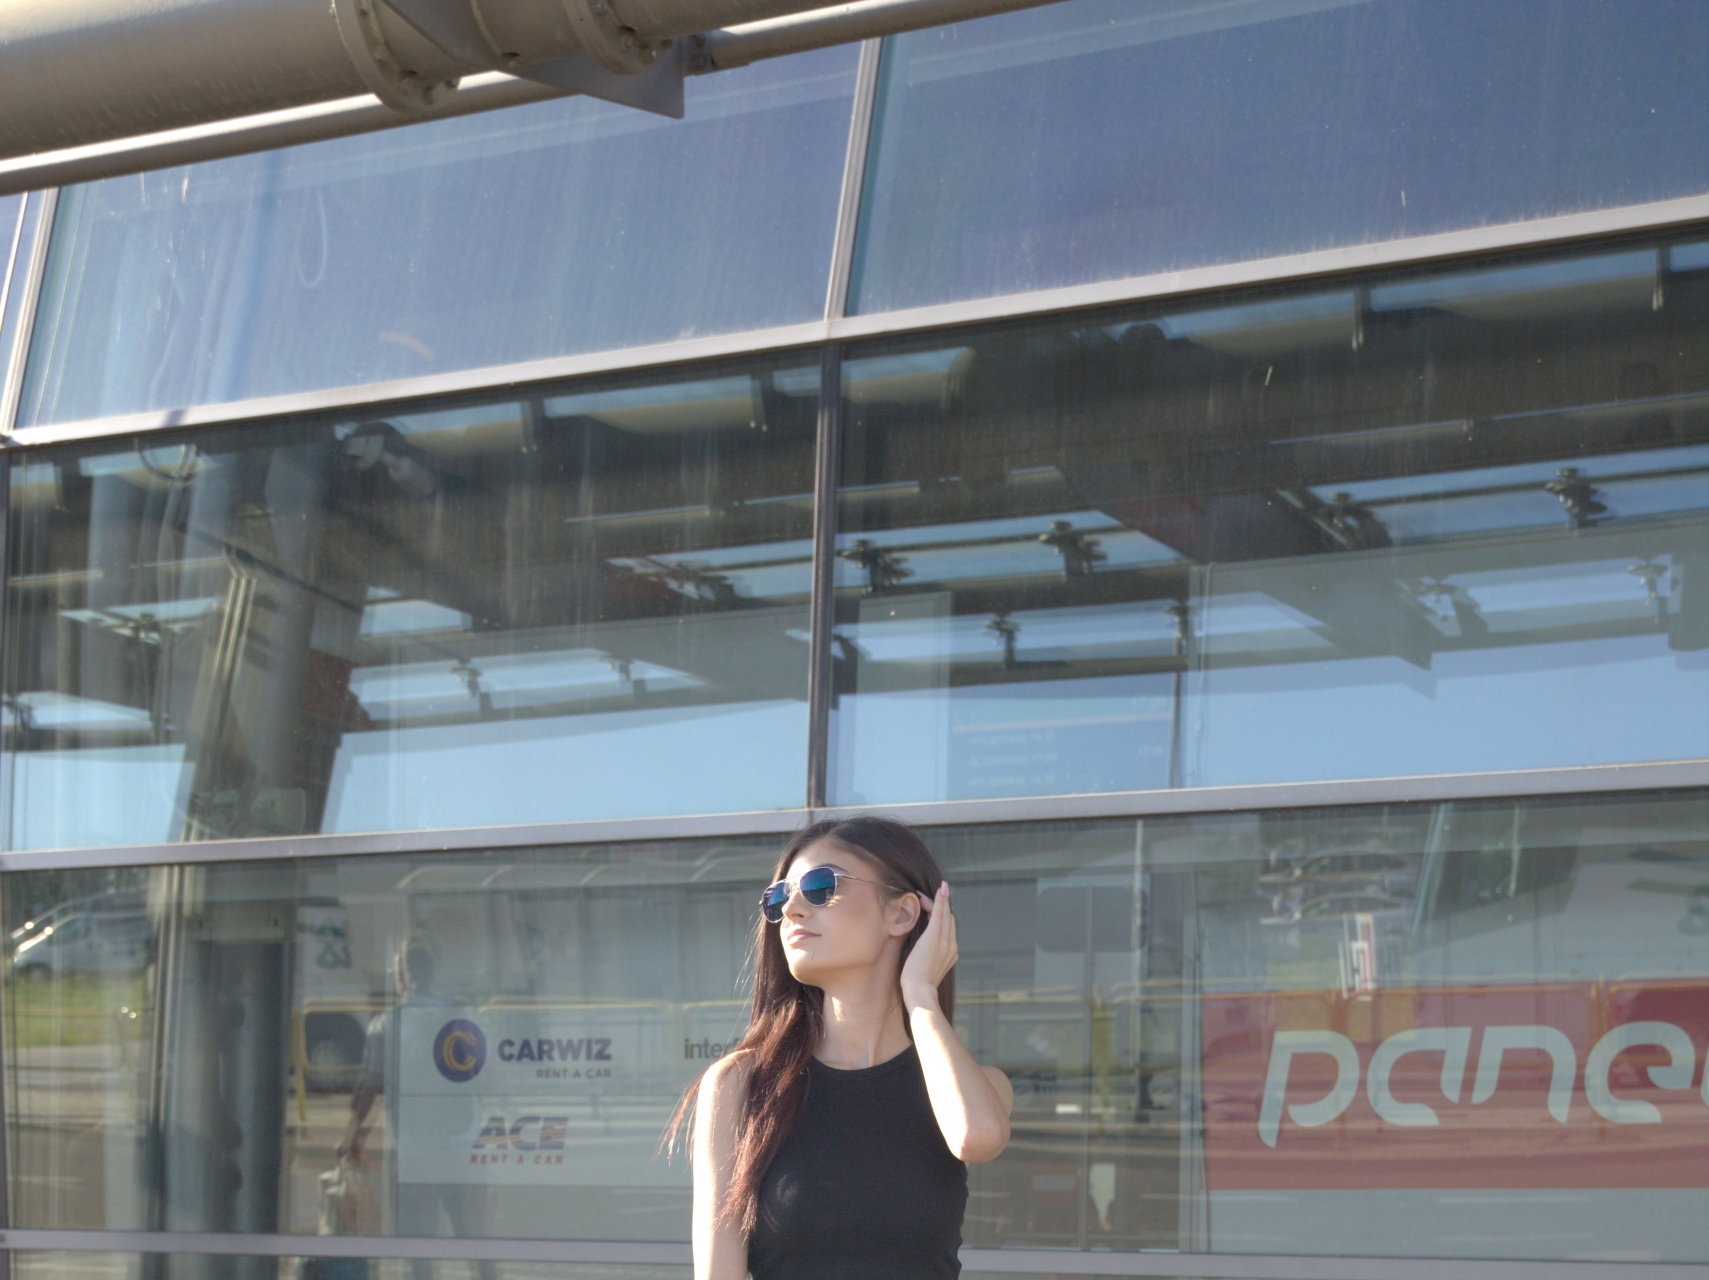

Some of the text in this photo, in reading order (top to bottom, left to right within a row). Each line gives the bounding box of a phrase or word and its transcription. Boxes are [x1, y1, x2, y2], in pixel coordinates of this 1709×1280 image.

[497, 1038, 612, 1062] CARWIZ
[535, 1068, 612, 1079] RENT A CAR
[1258, 1021, 1709, 1149] pane
[472, 1116, 569, 1151] ACE
[470, 1154, 564, 1165] RENT A CAR
